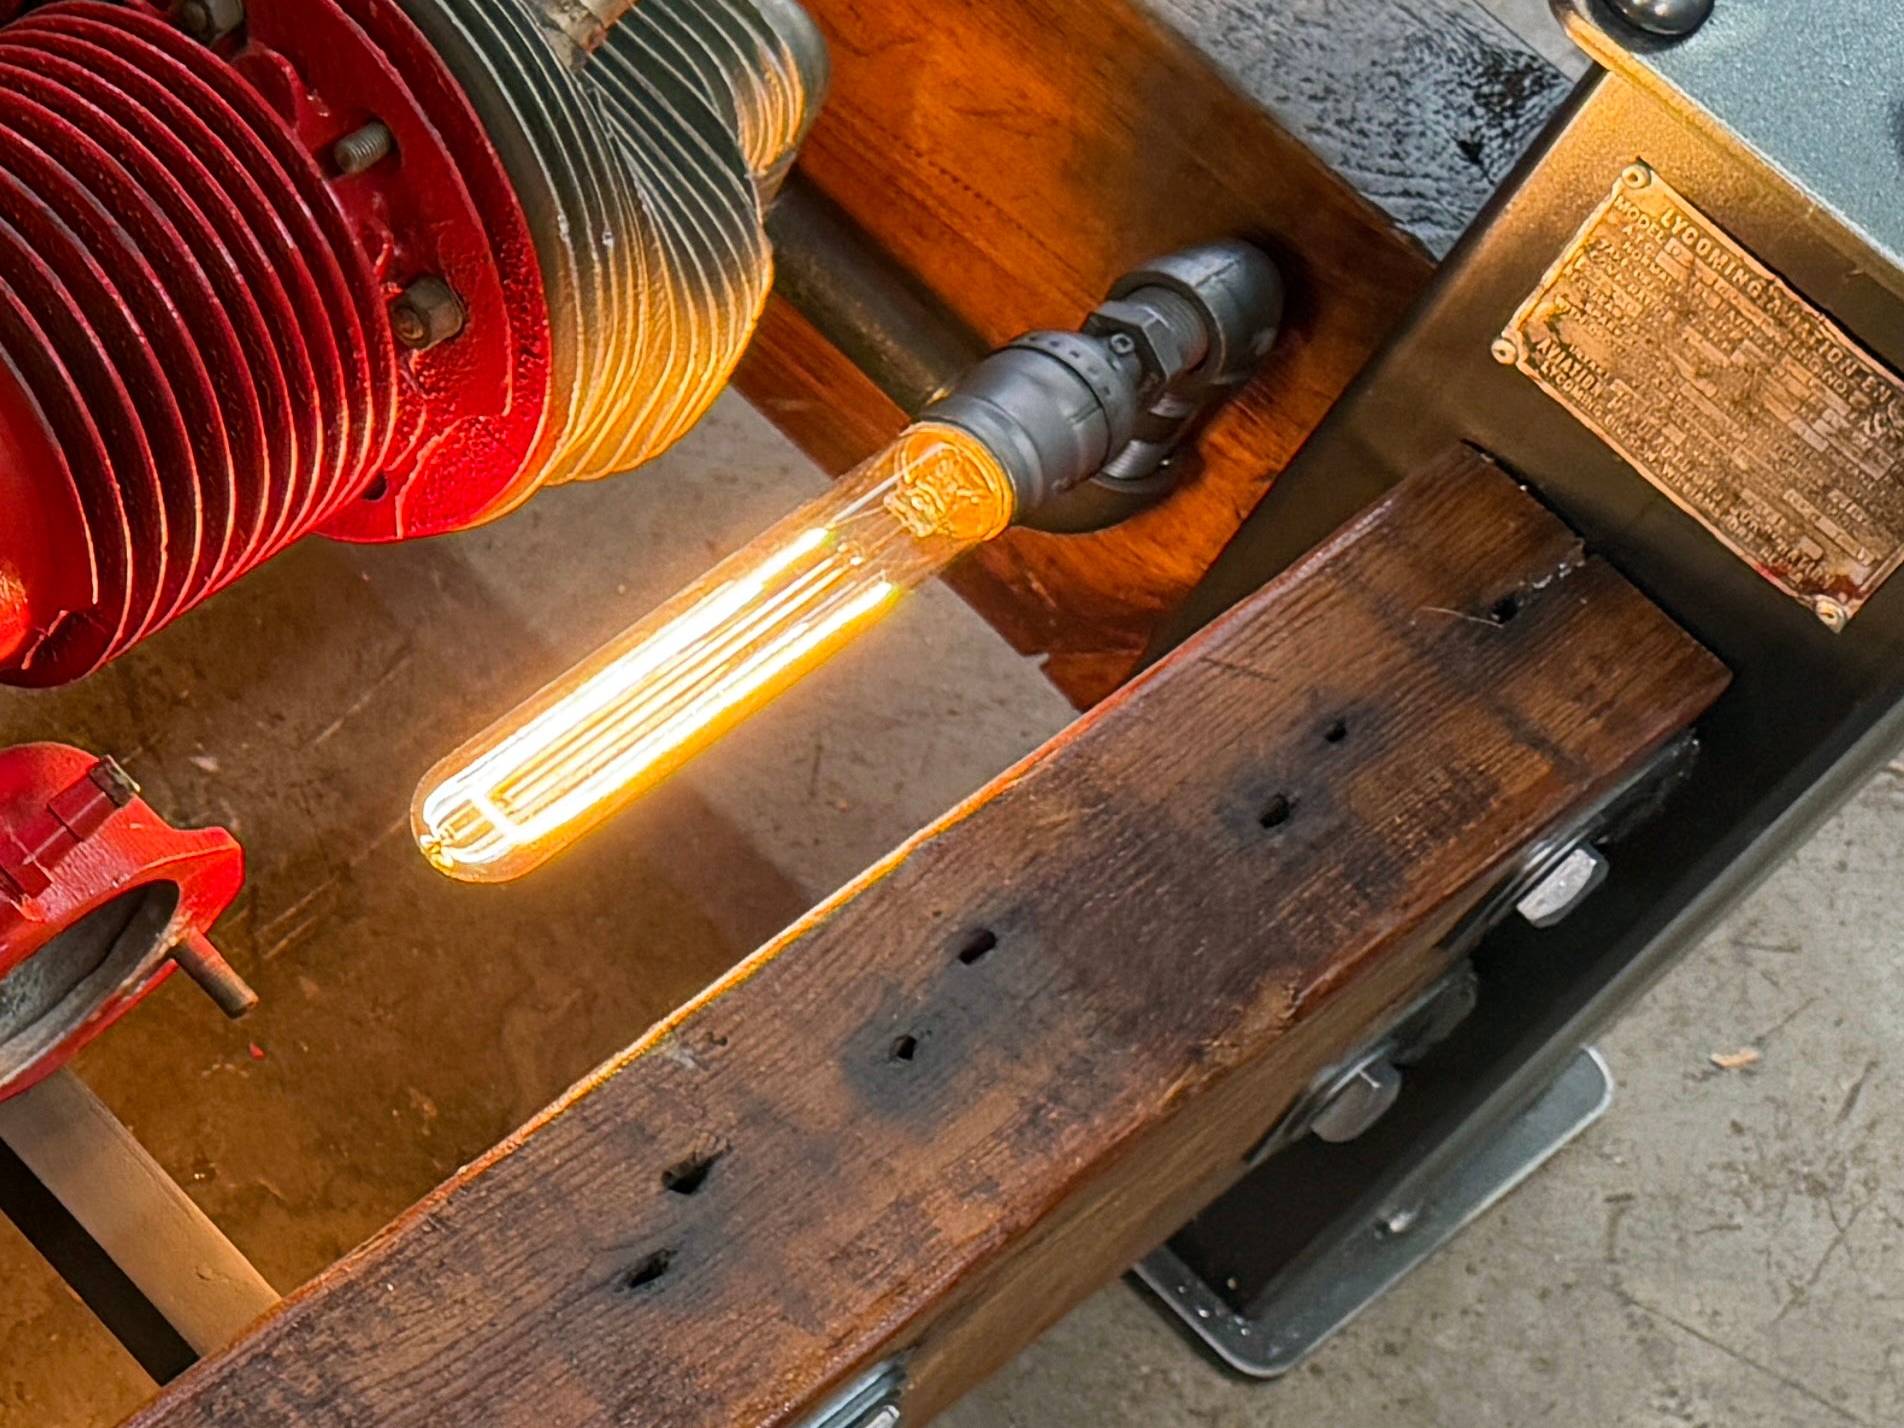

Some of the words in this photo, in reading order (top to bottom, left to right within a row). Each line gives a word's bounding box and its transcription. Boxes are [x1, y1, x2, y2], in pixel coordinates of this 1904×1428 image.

[1611, 194, 1669, 245] MODEL
[1657, 205, 1765, 300] LYCOMING
[1534, 334, 1607, 398] AVIATION
[1538, 358, 1605, 418] LYCOMING
